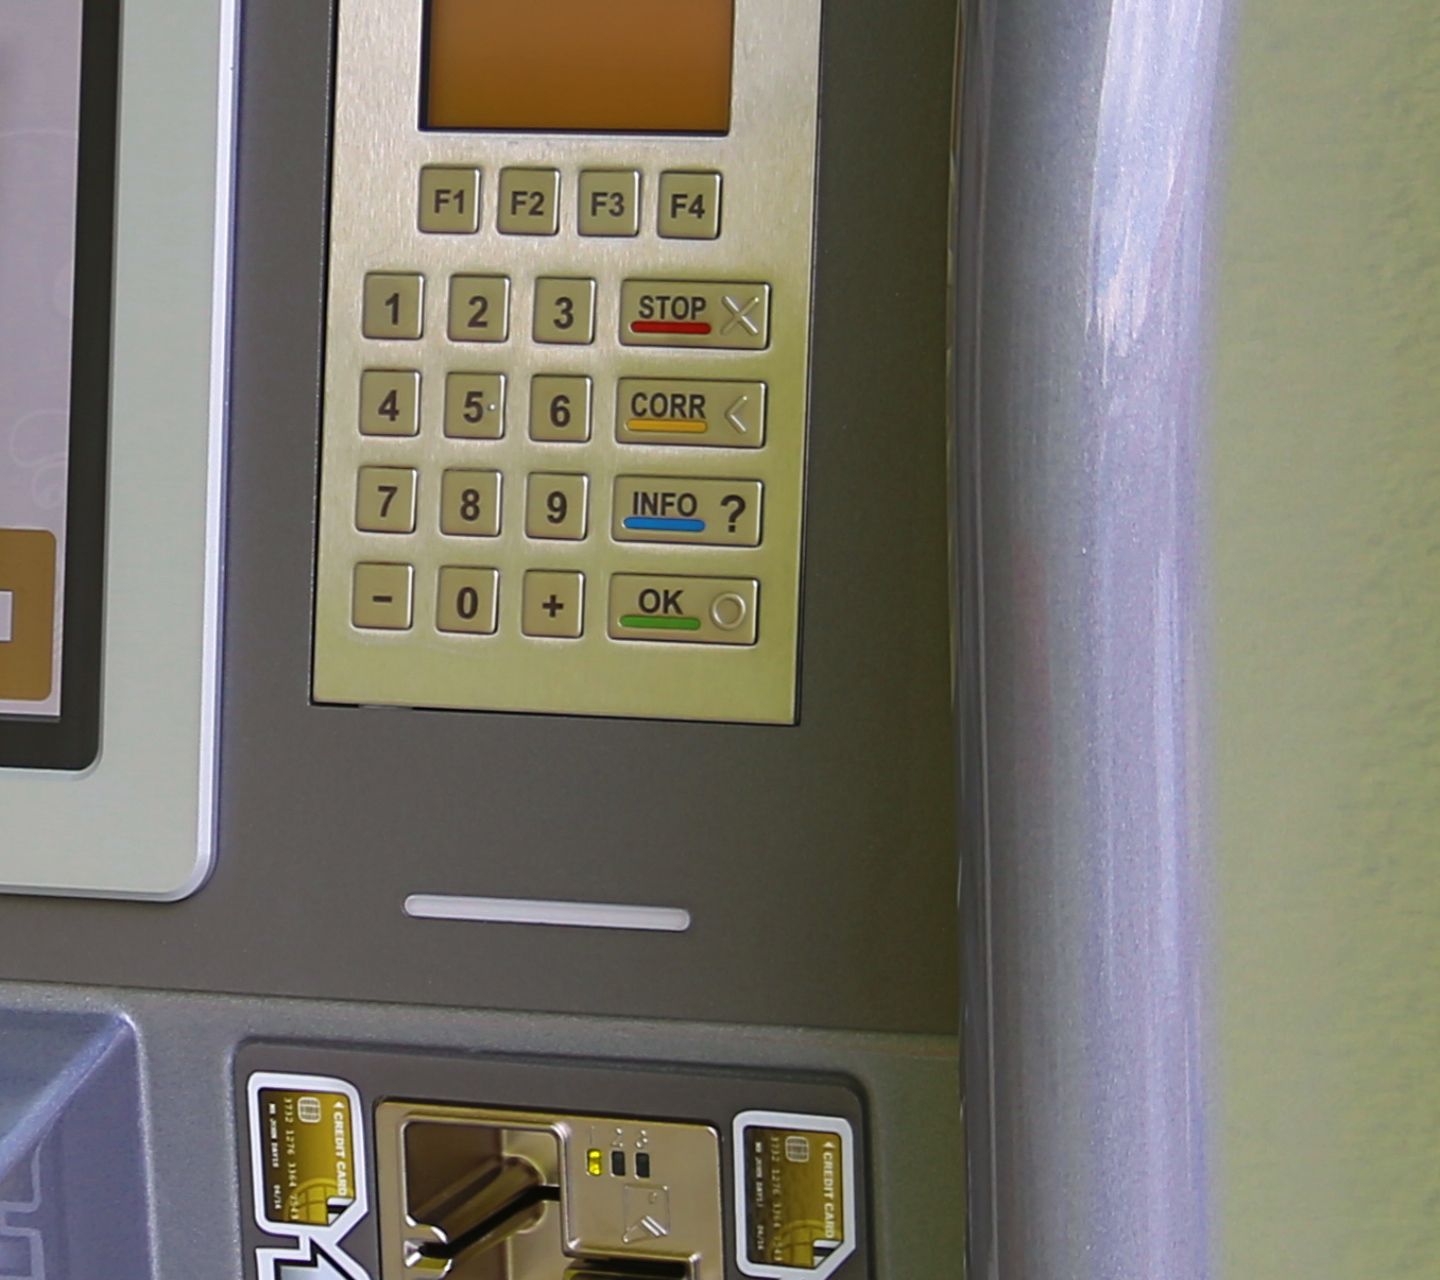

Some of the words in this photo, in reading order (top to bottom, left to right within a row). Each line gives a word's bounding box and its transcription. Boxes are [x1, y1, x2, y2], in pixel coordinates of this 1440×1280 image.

[433, 189, 465, 215] F1
[510, 191, 545, 216] F2
[590, 192, 625, 217] F3
[669, 194, 706, 219] F4
[384, 293, 401, 326] 1
[467, 295, 489, 329] 2
[553, 297, 575, 330] 3
[638, 294, 707, 321] STOP
[378, 389, 400, 422] 4
[463, 391, 484, 423] 5
[549, 395, 571, 428] 6
[630, 392, 707, 420] CORR
[377, 486, 398, 518] 7
[459, 489, 481, 522] 8
[546, 491, 568, 524] 9
[632, 491, 698, 517] INFO
[456, 587, 478, 620] 0
[638, 589, 684, 616] OK
[333, 1111, 346, 1159] CREDIT
[336, 1161, 348, 1197] CARD
[822, 1151, 834, 1200] CREDIT
[824, 1202, 835, 1239] CARD
